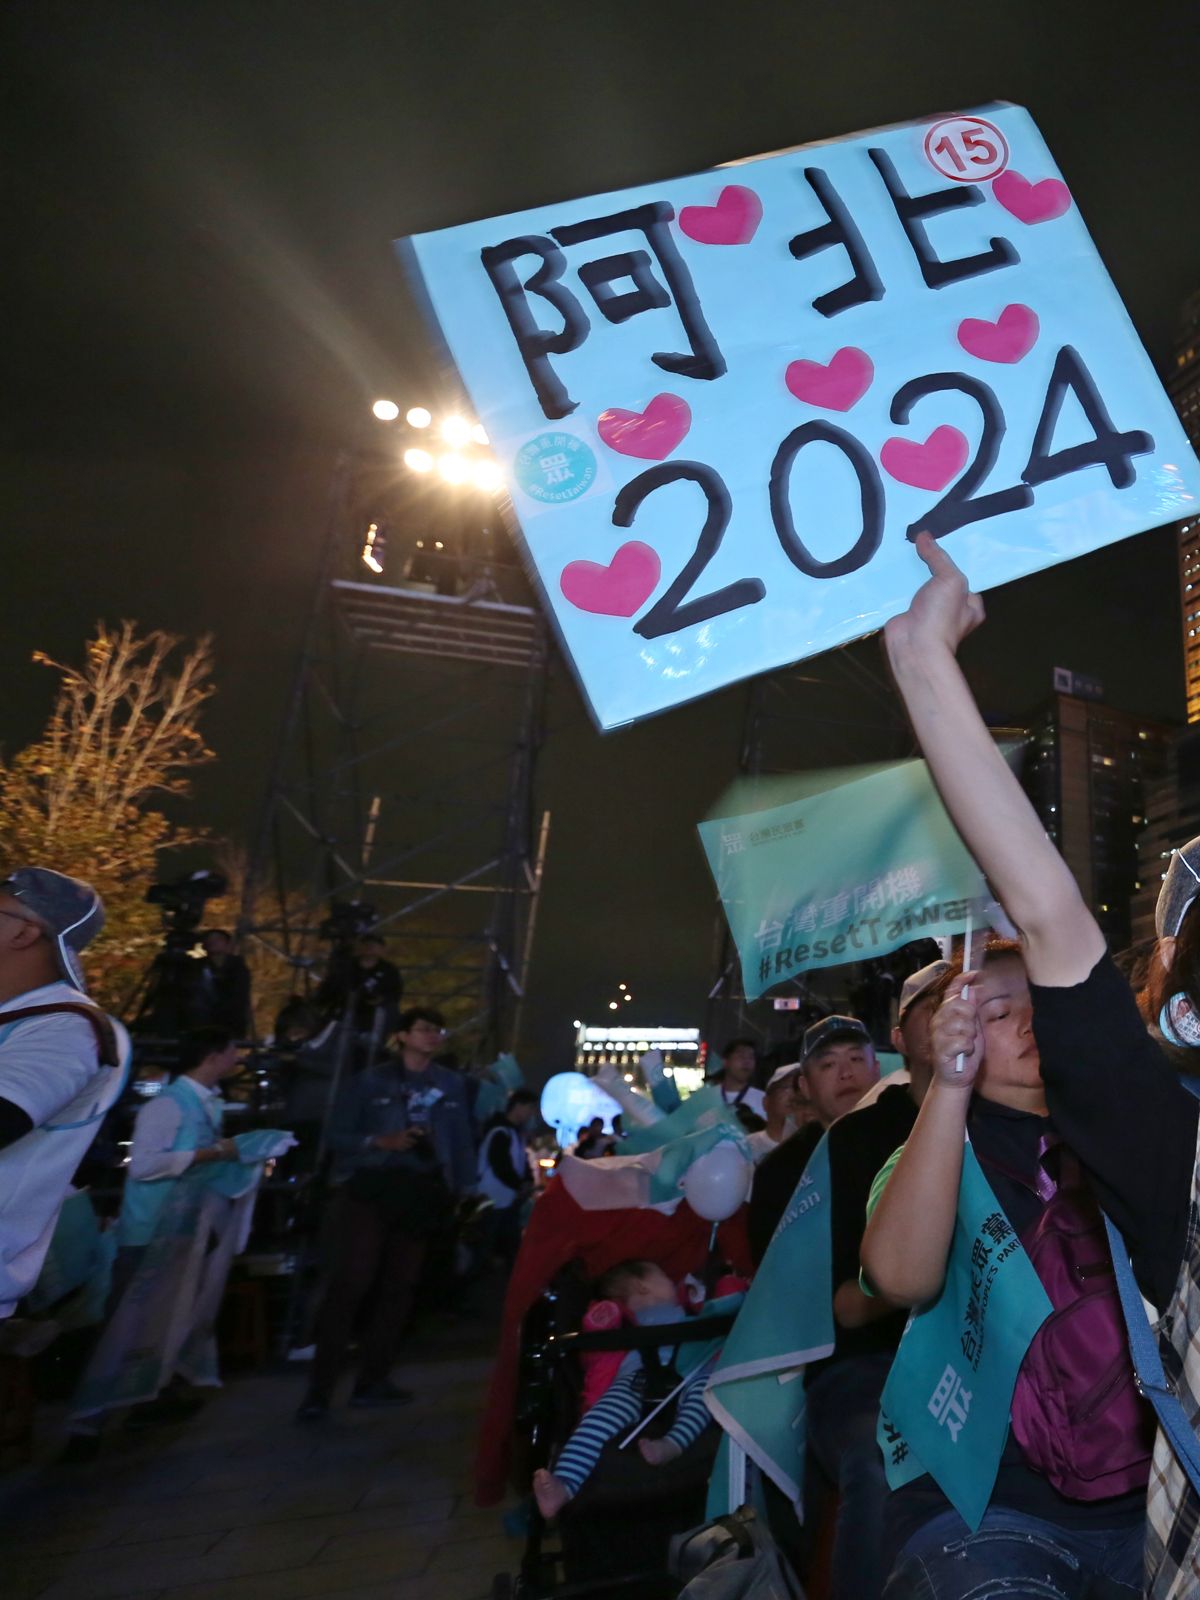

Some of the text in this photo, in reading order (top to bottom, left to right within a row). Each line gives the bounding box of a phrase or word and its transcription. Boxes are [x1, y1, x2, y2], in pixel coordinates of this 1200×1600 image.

[934, 126, 997, 173] 15
[481, 147, 1020, 419] 阿北
[612, 343, 1155, 640] 2024
[758, 899, 971, 982] #ResetTaiwa
